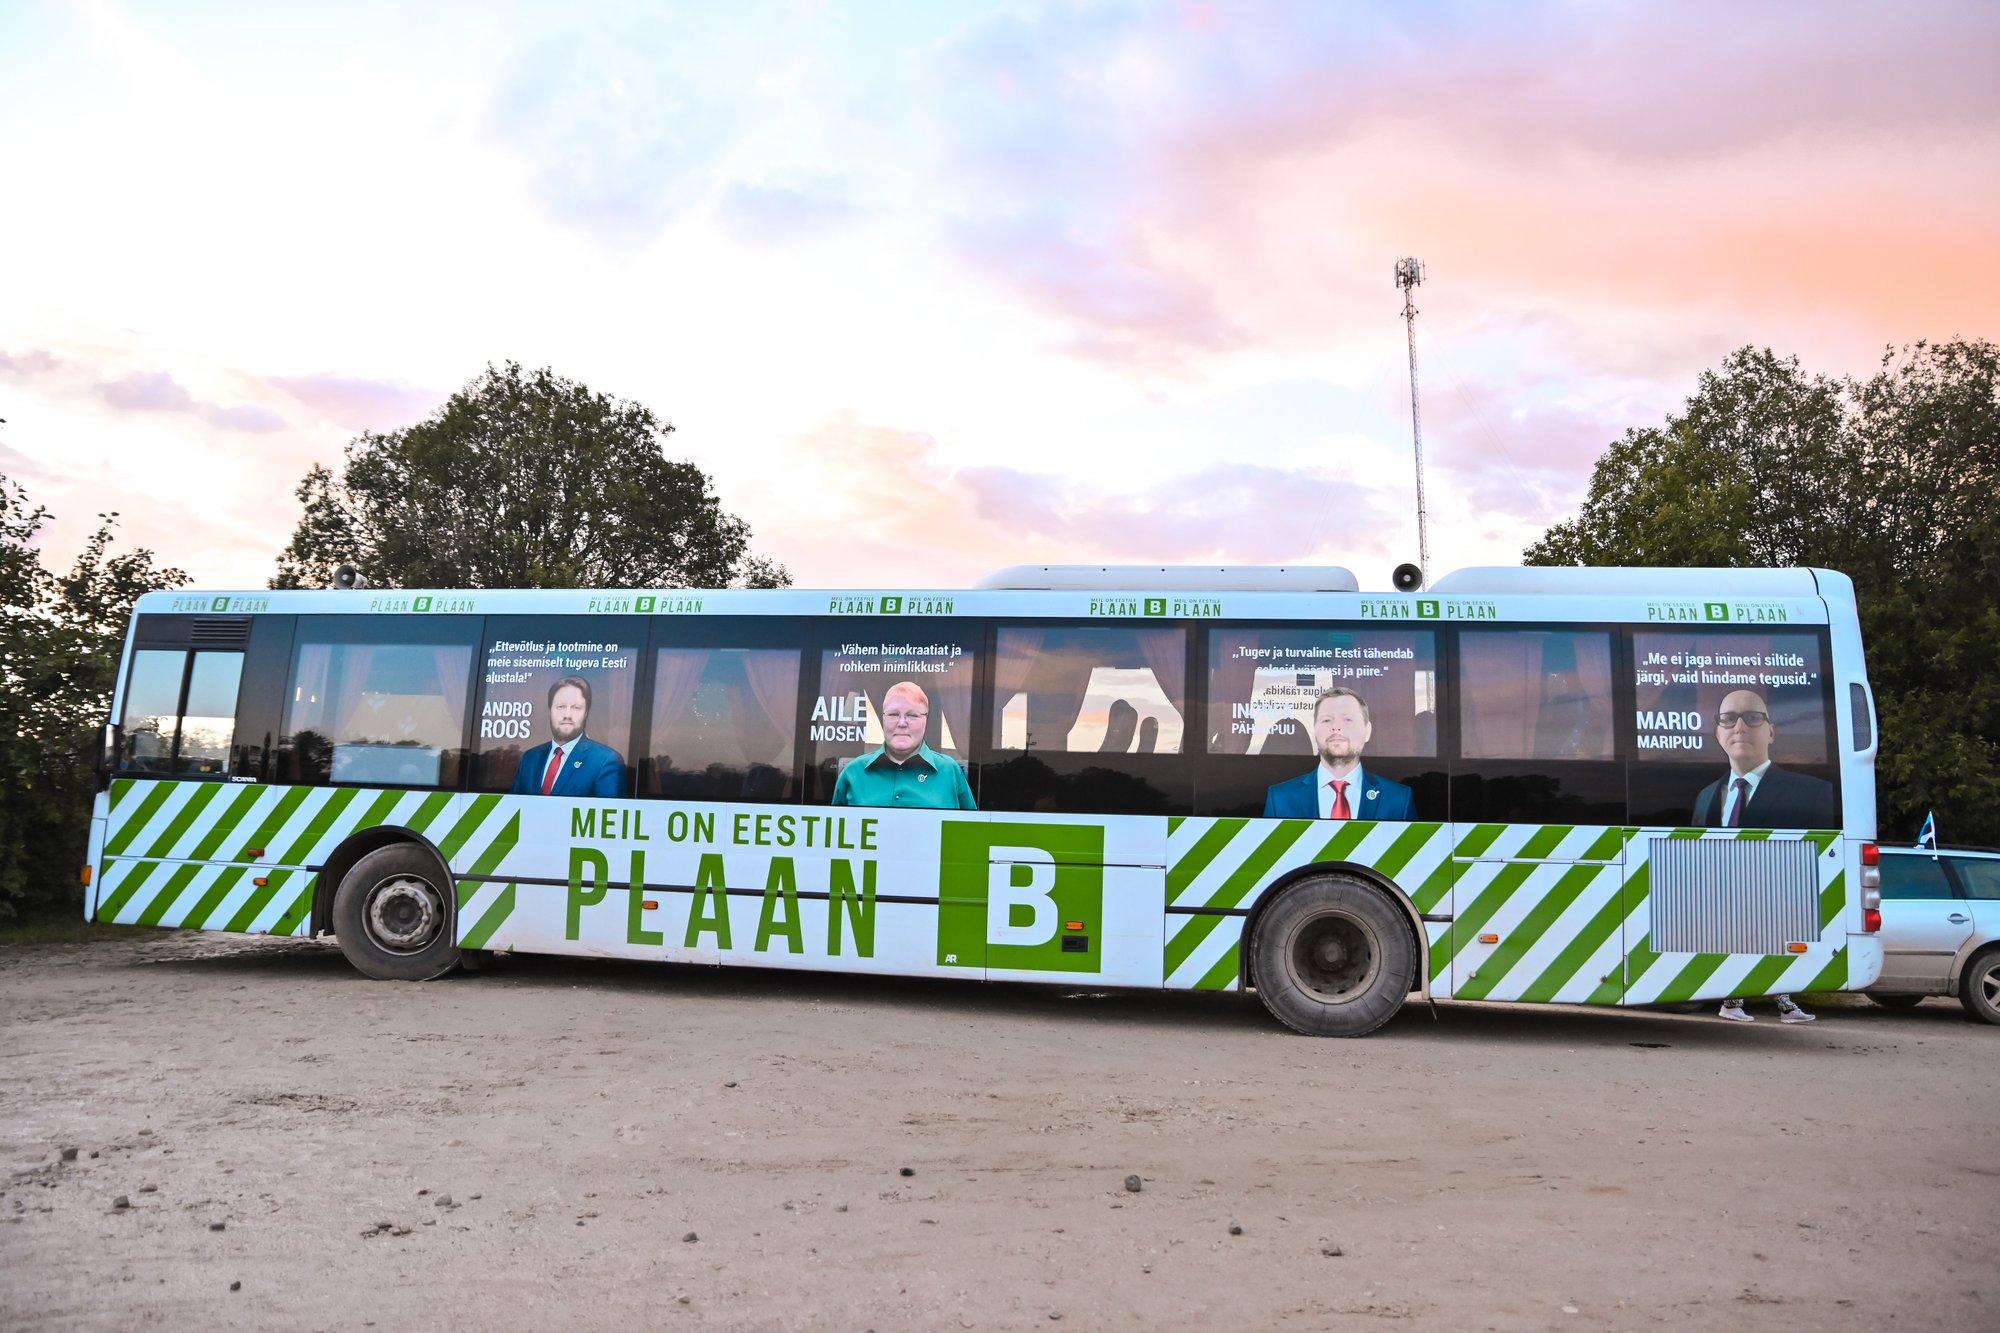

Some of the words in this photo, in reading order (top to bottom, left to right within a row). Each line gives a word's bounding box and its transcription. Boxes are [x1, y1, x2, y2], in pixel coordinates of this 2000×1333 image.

[370, 601, 409, 612] PLAAN
[436, 601, 474, 612] PLAAN
[589, 601, 629, 612] PLAAN
[660, 601, 702, 612] PLAAN
[829, 601, 874, 613] PLAAN
[908, 602, 953, 614] PLAAN
[1090, 603, 1137, 615] PLAAN
[1174, 604, 1221, 616] PLAAN
[1361, 605, 1409, 618] PLAAN
[1448, 606, 1496, 619] PLAAN
[1648, 607, 1697, 621] PLAAN
[1737, 608, 1787, 622] PLAAN
[545, 641, 555, 654] ja
[558, 641, 603, 652] tootmine
[605, 644, 618, 652] on
[881, 643, 949, 656] bürokraatiat
[950, 644, 961, 658] ja
[1272, 646, 1283, 660] ja
[1285, 647, 1332, 658] turvaline
[1335, 647, 1361, 659] Eesti
[1363, 648, 1414, 659] tähendab
[487, 656, 512, 667] meie
[513, 656, 564, 668] sisemiselt
[565, 657, 599, 671] tugeva
[601, 657, 627, 668] Eesti
[839, 660, 881, 673] rohkem
[1670, 652, 1682, 665] ei
[1684, 652, 1712, 668] jaga
[1715, 652, 1761, 666] inimesi
[1764, 653, 1804, 667] siltide
[1343, 665, 1353, 679] ja
[1636, 670, 1669, 686] järgi,
[1671, 670, 1698, 684] vaid
[1701, 670, 1756, 684] hindame
[482, 701, 533, 718] ANDRO
[811, 696, 868, 722] AILE
[1636, 711, 1702, 731] MARIO
[480, 719, 532, 739] ROOS
[810, 726, 867, 742] MOSEN
[1637, 735, 1703, 750] MARIPUU
[570, 807, 650, 841] MEIL
[667, 810, 715, 843] ON
[732, 813, 879, 851] EESTILE
[565, 846, 878, 958] PLAAN
[986, 845, 1058, 947] B
